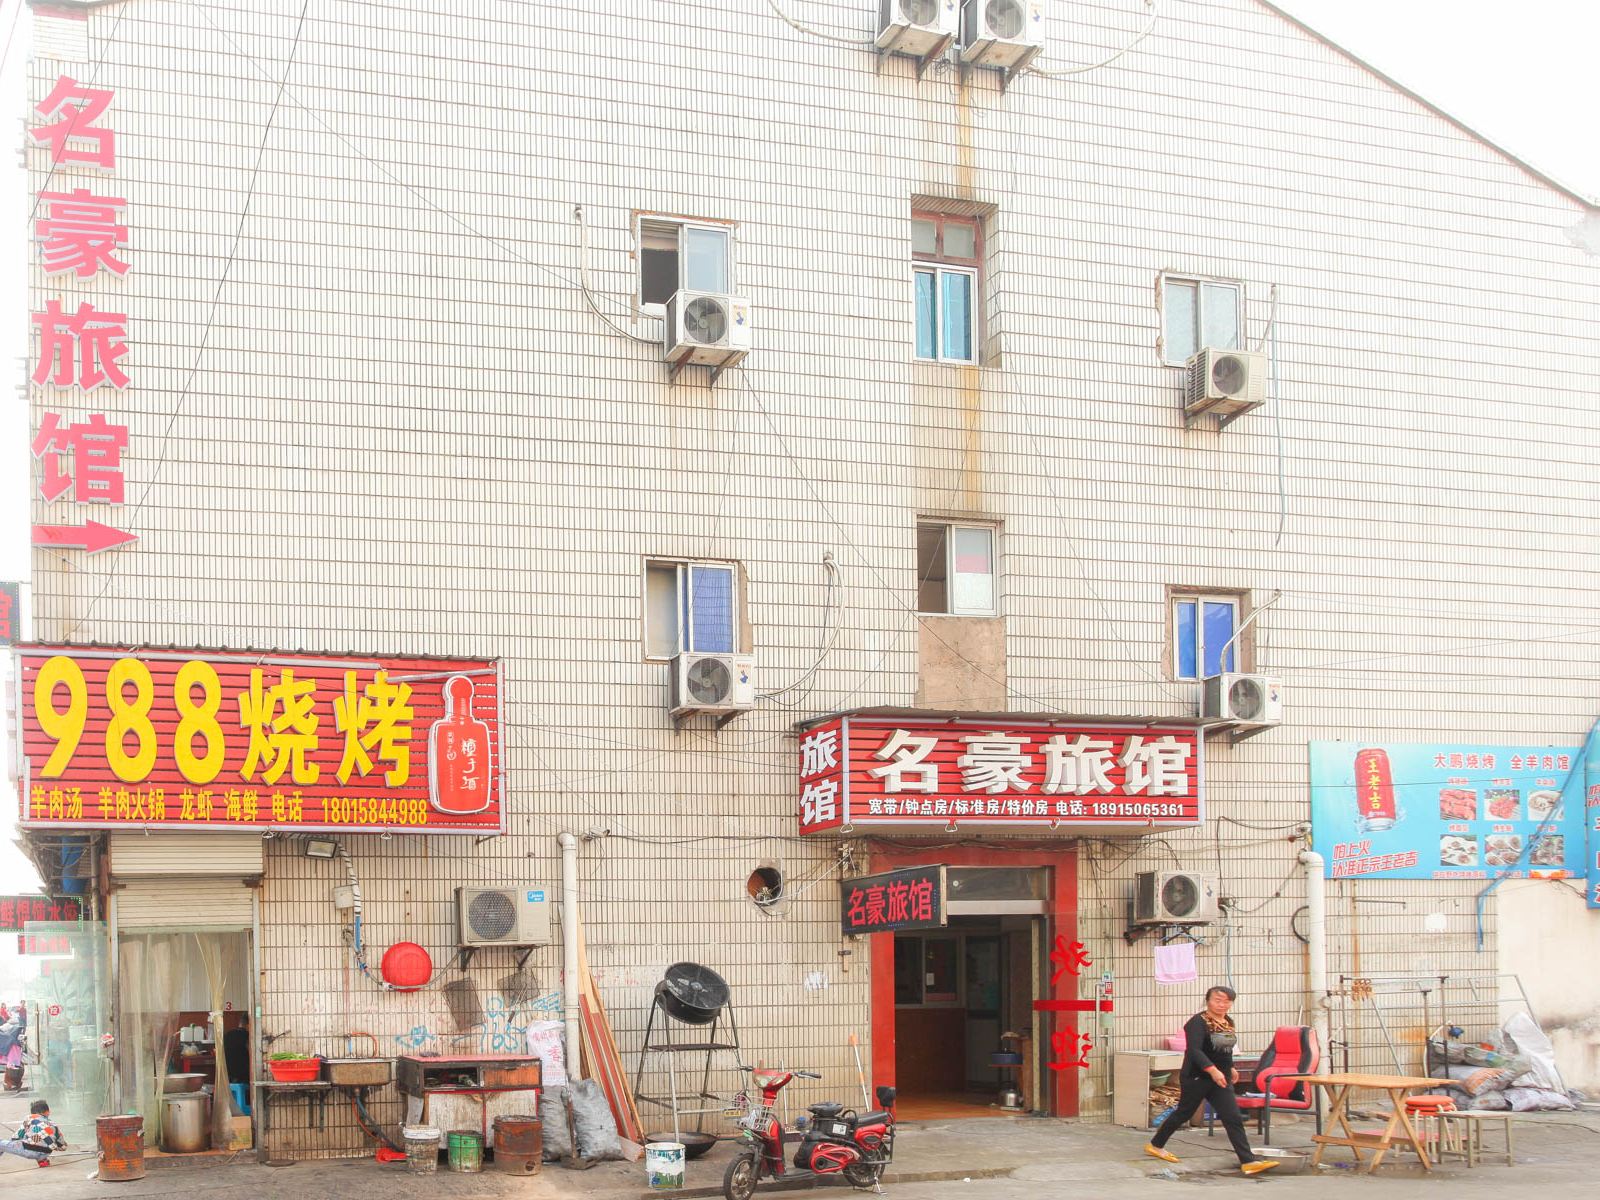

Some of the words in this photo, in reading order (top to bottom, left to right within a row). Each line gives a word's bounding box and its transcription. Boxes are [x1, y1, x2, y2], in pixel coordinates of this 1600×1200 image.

[30, 75, 131, 507] 名豪旅馆
[33, 656, 414, 787] 988烧烤
[800, 730, 838, 826] 旅馆
[867, 729, 1192, 796] 名豪旅馆
[1367, 758, 1382, 810] 王老吉
[1433, 753, 1496, 770] 大鹏烧烤
[1510, 755, 1570, 771] 全羊肉馆
[31, 787, 83, 819] 羊肉汤
[98, 788, 165, 820] 羊肉火锅
[179, 790, 213, 821] 龙虾
[223, 790, 259, 822] 海鲜
[272, 791, 304, 823] 电话
[321, 798, 428, 825] 18015844988
[868, 799, 1049, 816] 宽带/钟点房/标准房/特价房
[1092, 803, 1184, 816] 18915065361
[1332, 850, 1420, 879] 认准正宗王老吉
[1333, 840, 1372, 861] 怕上火
[847, 876, 933, 928] 名豪旅馆
